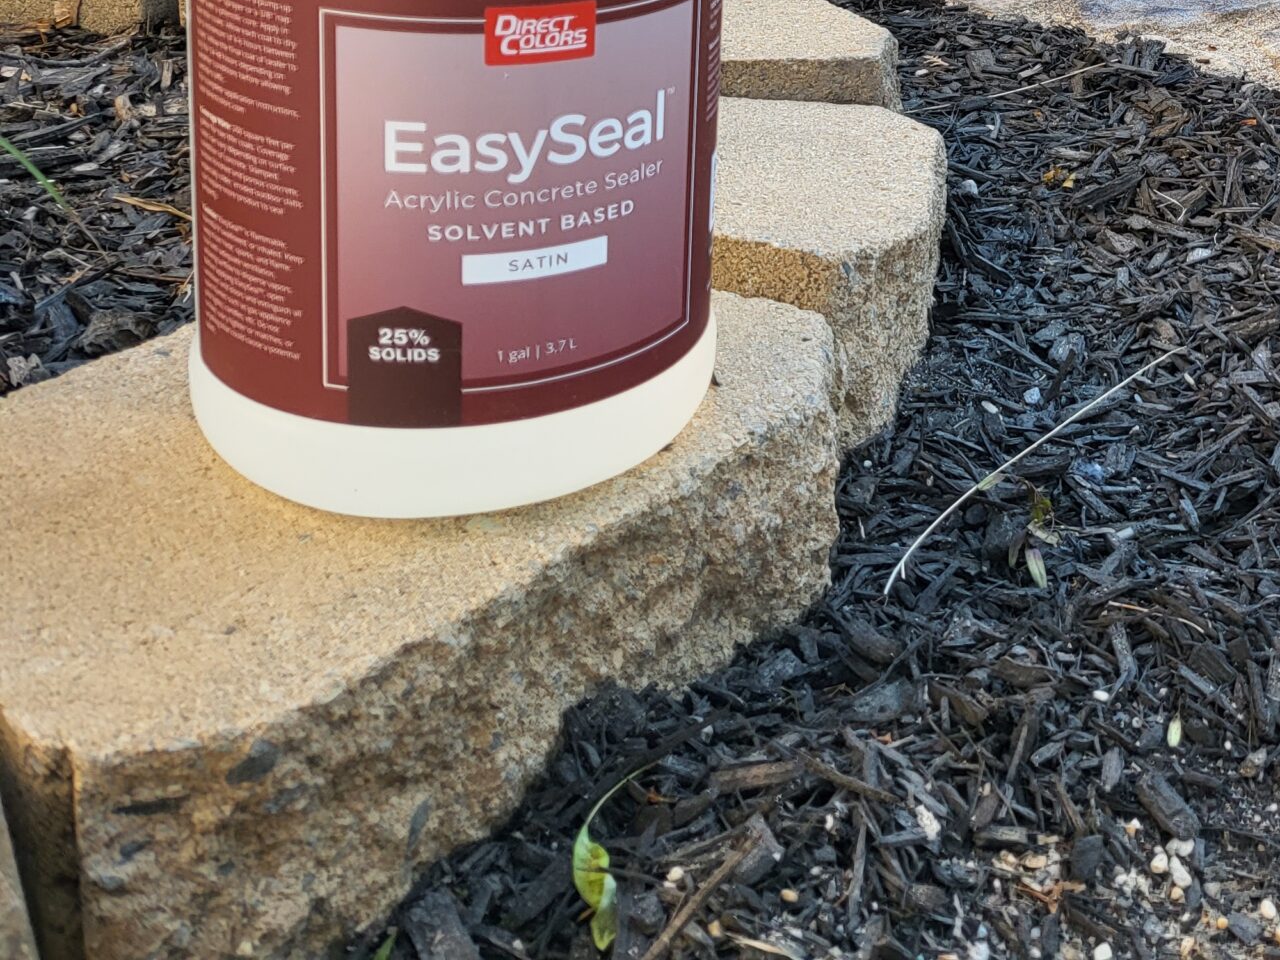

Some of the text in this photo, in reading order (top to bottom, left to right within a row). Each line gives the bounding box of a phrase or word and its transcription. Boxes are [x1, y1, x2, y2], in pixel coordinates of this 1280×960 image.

[494, 14, 578, 37] DIRECT
[500, 28, 588, 56] COLORS
[384, 159, 663, 213] Acrylic Concrete Sealer
[428, 200, 635, 241] SOLVENT BASED
[507, 252, 568, 272] SATIN
[378, 327, 430, 346] 25%
[368, 346, 441, 363] SOLIDS
[508, 344, 530, 364] gal
